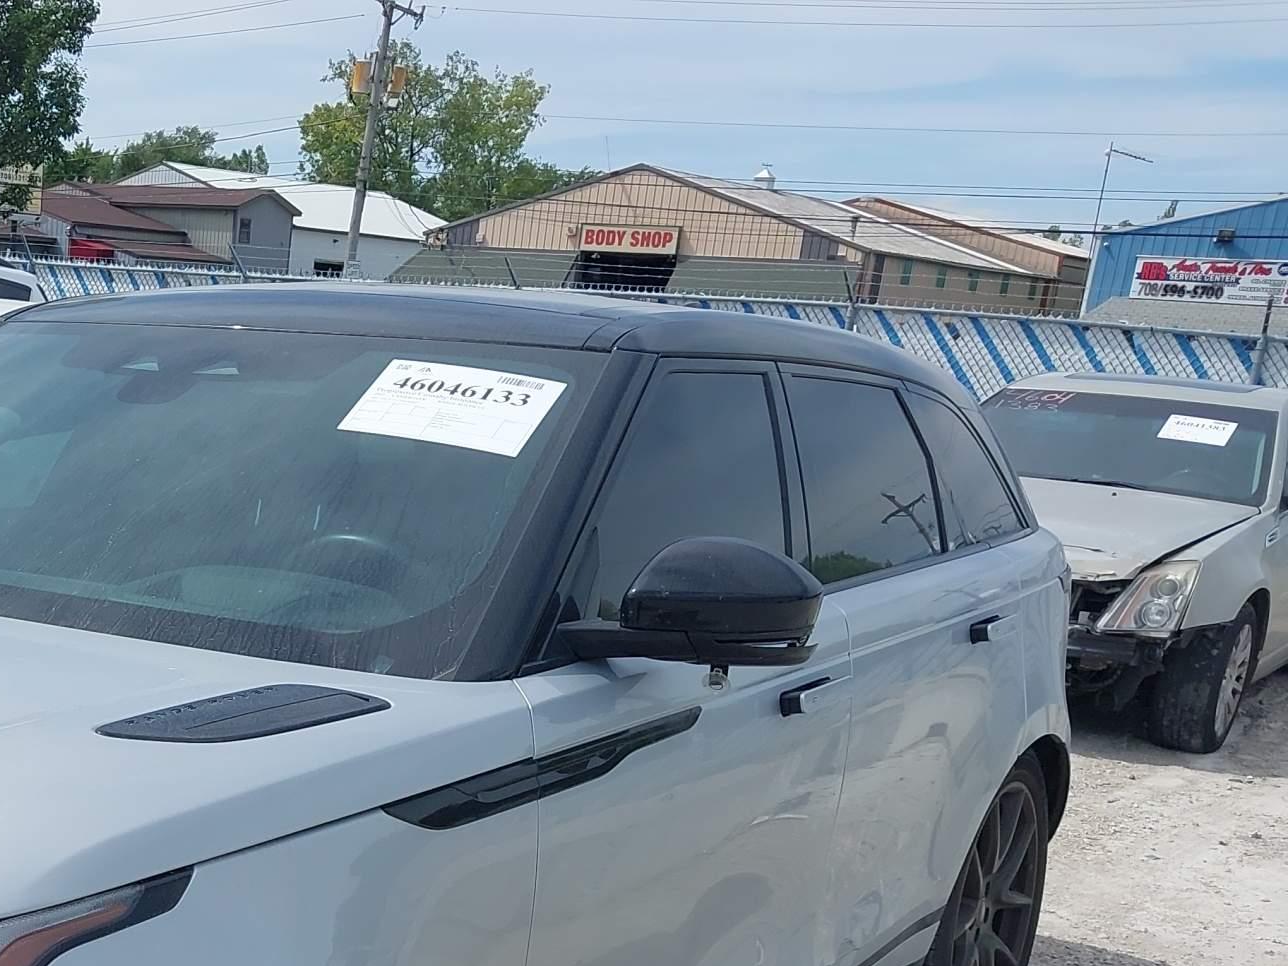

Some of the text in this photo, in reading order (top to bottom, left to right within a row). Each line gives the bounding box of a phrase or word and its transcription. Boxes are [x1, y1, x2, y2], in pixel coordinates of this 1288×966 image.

[584, 229, 673, 248] BODY SHOP
[1169, 273, 1237, 283] SERVICE CENTER
[393, 376, 532, 407] 46046133
